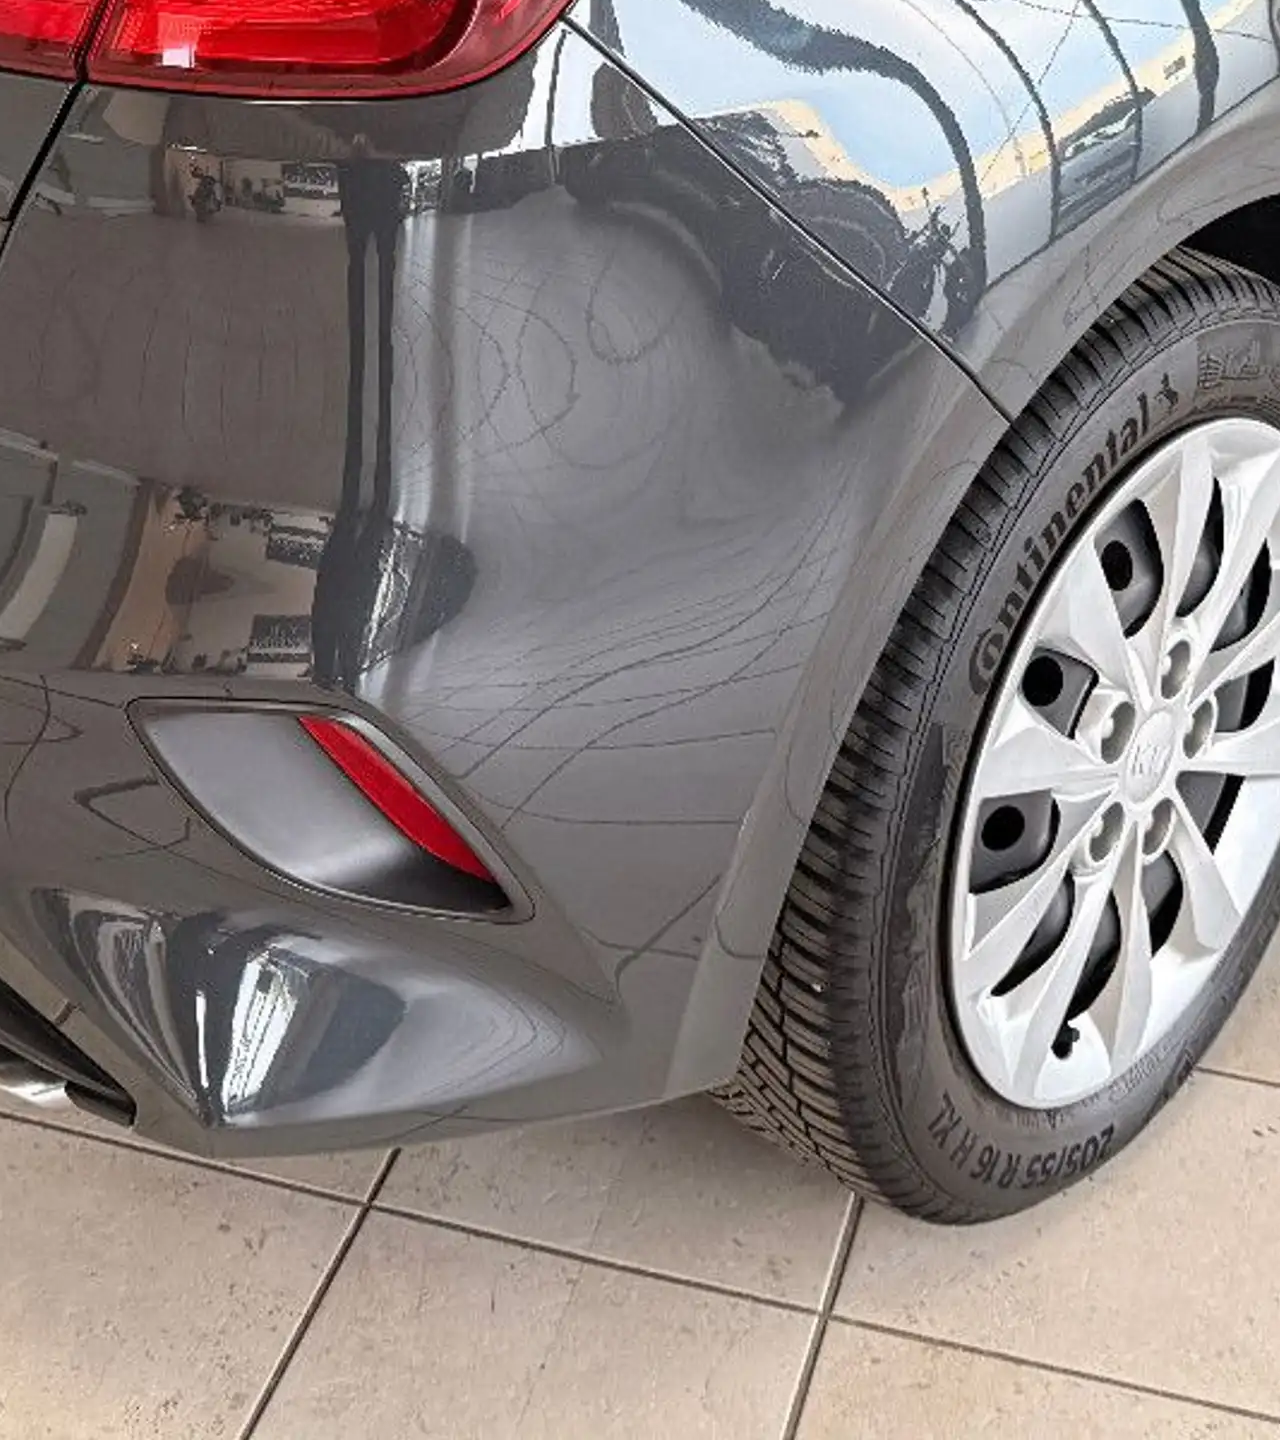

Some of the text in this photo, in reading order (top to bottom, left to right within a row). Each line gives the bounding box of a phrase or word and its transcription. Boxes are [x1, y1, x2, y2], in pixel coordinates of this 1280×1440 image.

[969, 391, 1151, 696] Continental
[927, 1090, 962, 1149] XL
[970, 1144, 1002, 1182] 16
[997, 1154, 1020, 1190] R
[1021, 1122, 1115, 1190] 205/55
